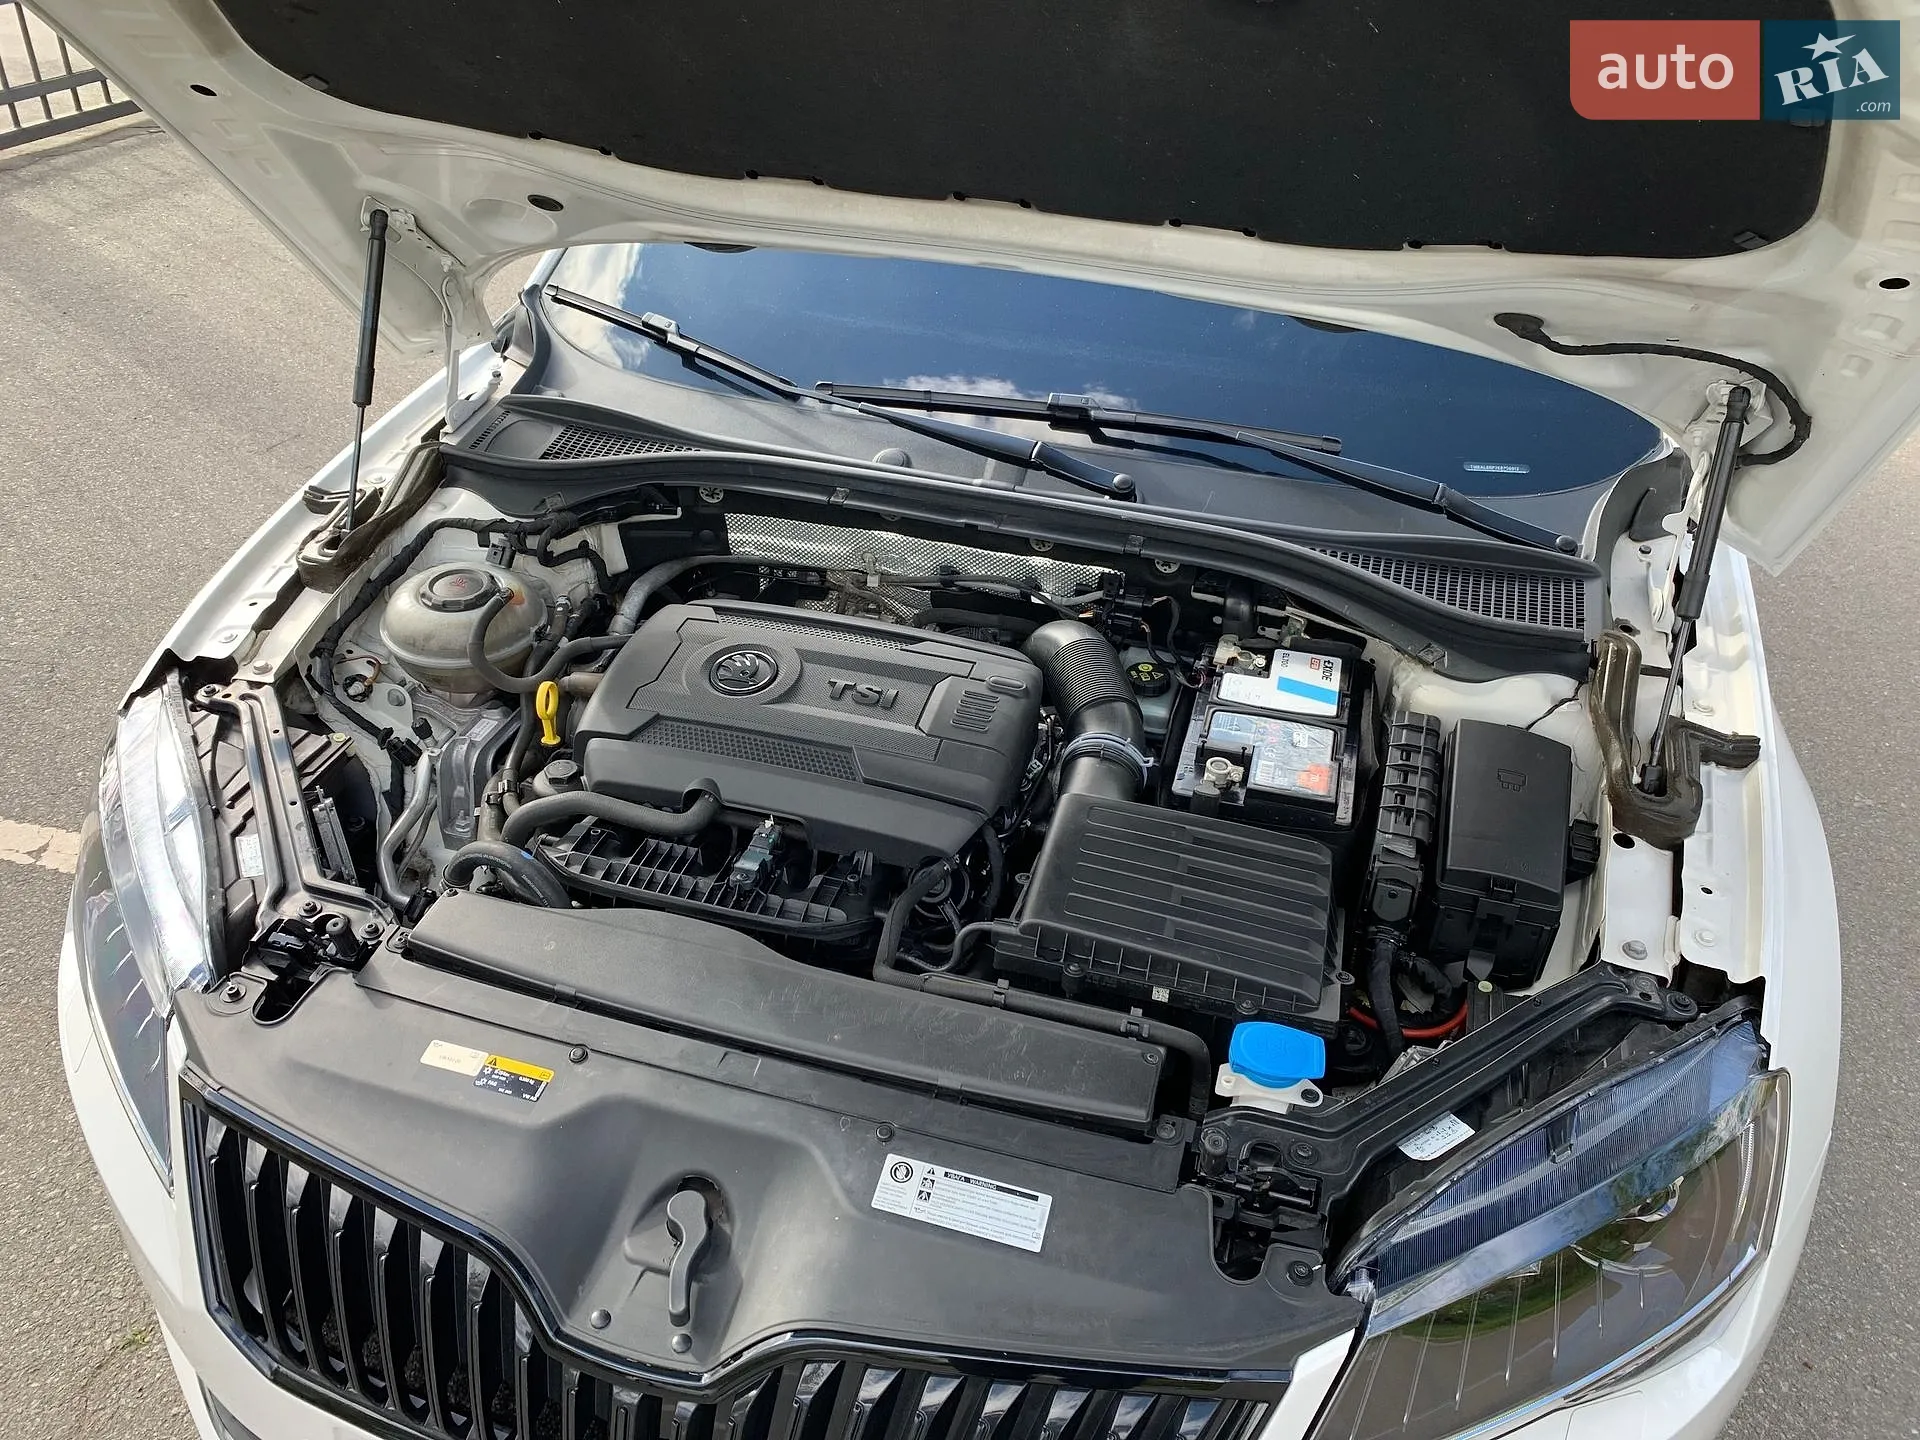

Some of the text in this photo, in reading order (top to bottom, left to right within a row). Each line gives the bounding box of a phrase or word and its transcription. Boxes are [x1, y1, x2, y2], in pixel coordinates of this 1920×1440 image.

[1321, 659, 1334, 682] EXIDE
[828, 678, 900, 708] TSI
[969, 1178, 997, 1190] WARNING
